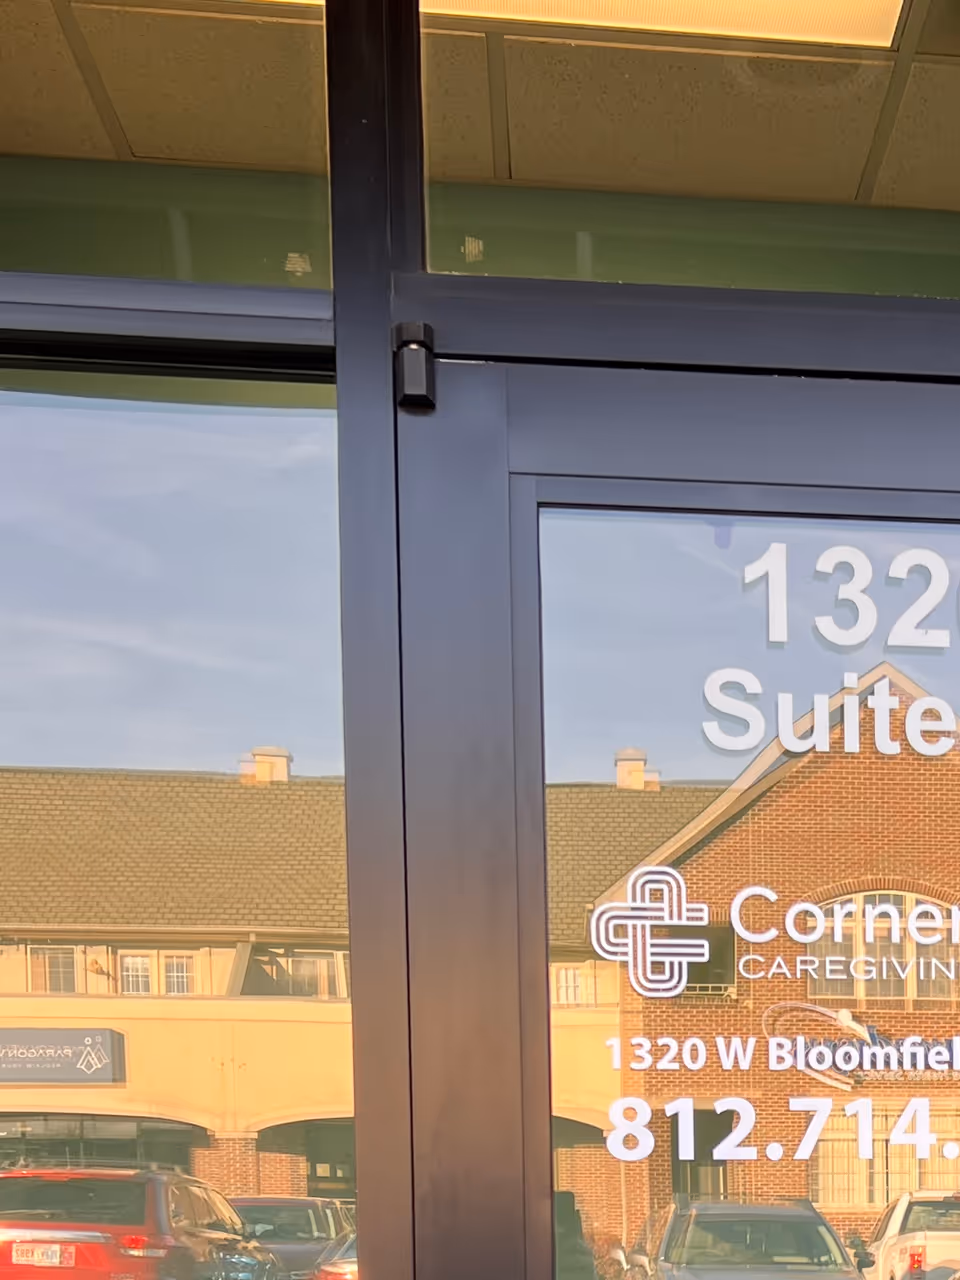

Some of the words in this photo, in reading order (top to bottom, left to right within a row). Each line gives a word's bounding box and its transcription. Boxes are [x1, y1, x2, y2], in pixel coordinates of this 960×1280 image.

[702, 668, 957, 756] Suite
[606, 1036, 707, 1070] 1320
[716, 1036, 756, 1070] W
